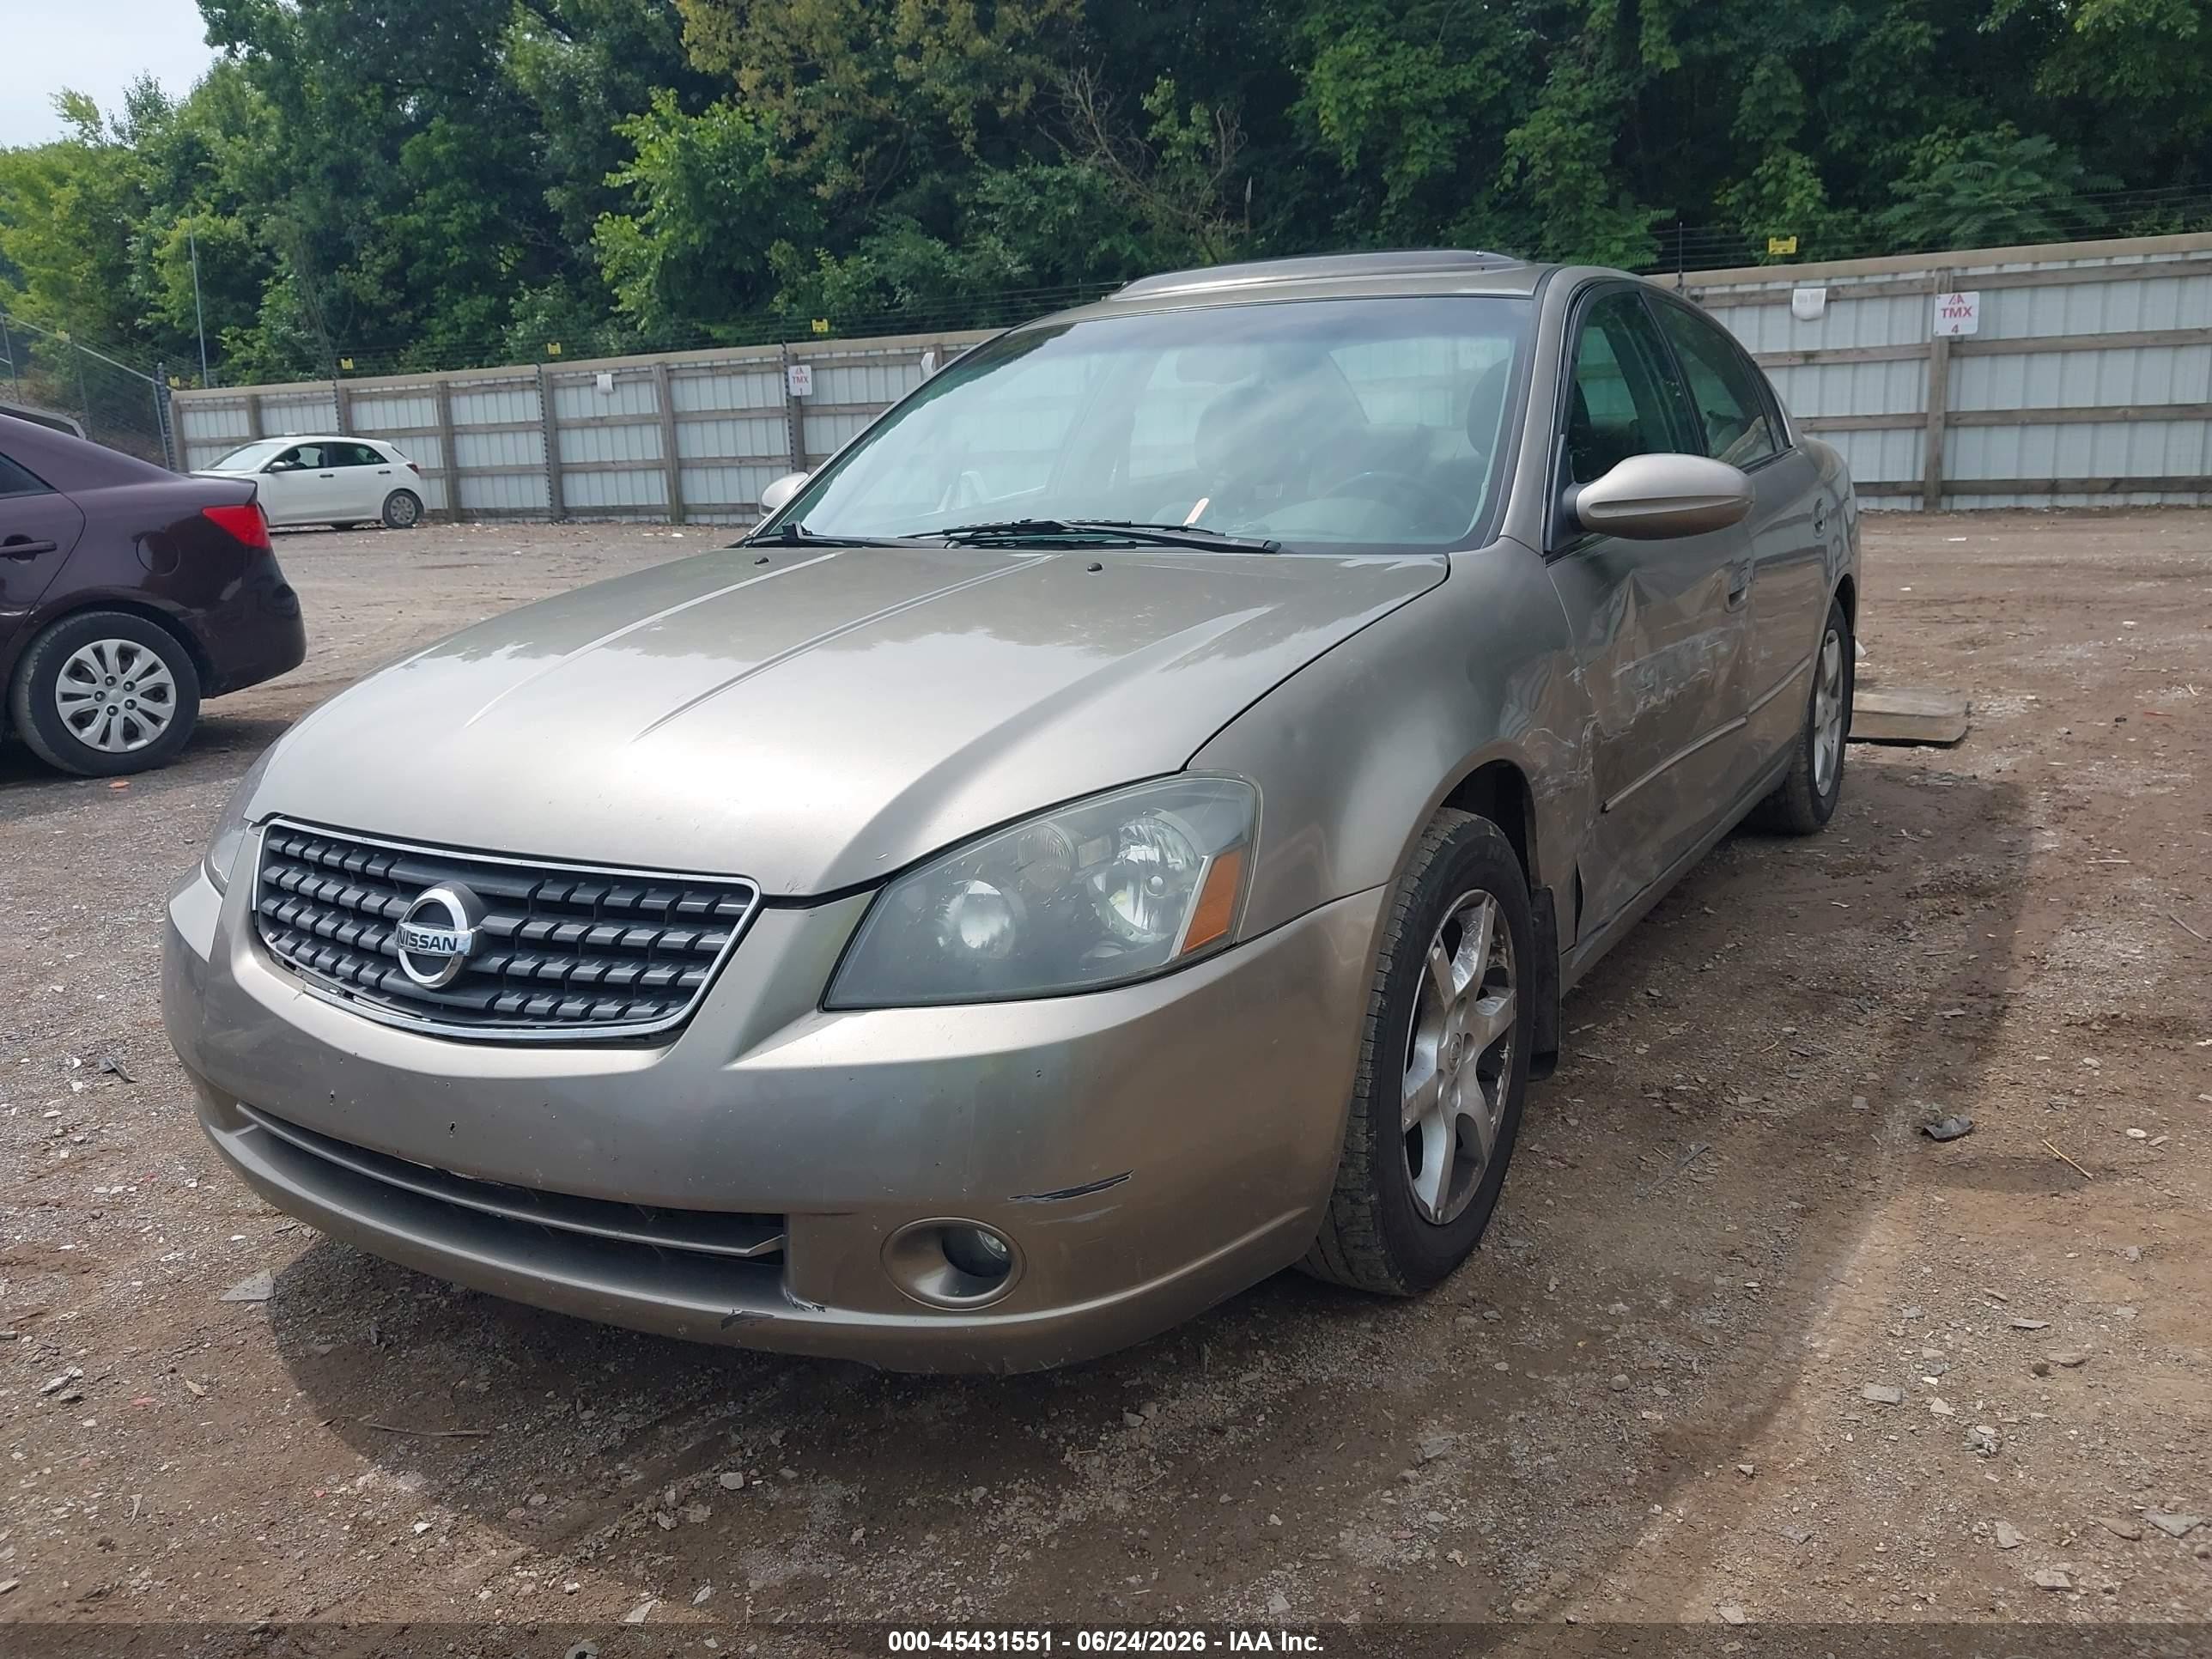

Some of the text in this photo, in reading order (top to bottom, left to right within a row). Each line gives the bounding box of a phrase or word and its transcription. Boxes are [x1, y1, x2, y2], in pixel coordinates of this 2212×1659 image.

[1940, 305, 1972, 319] TMX
[1951, 323, 1960, 334] 4
[792, 375, 809, 385] TMX
[399, 929, 458, 951] NISSAN
